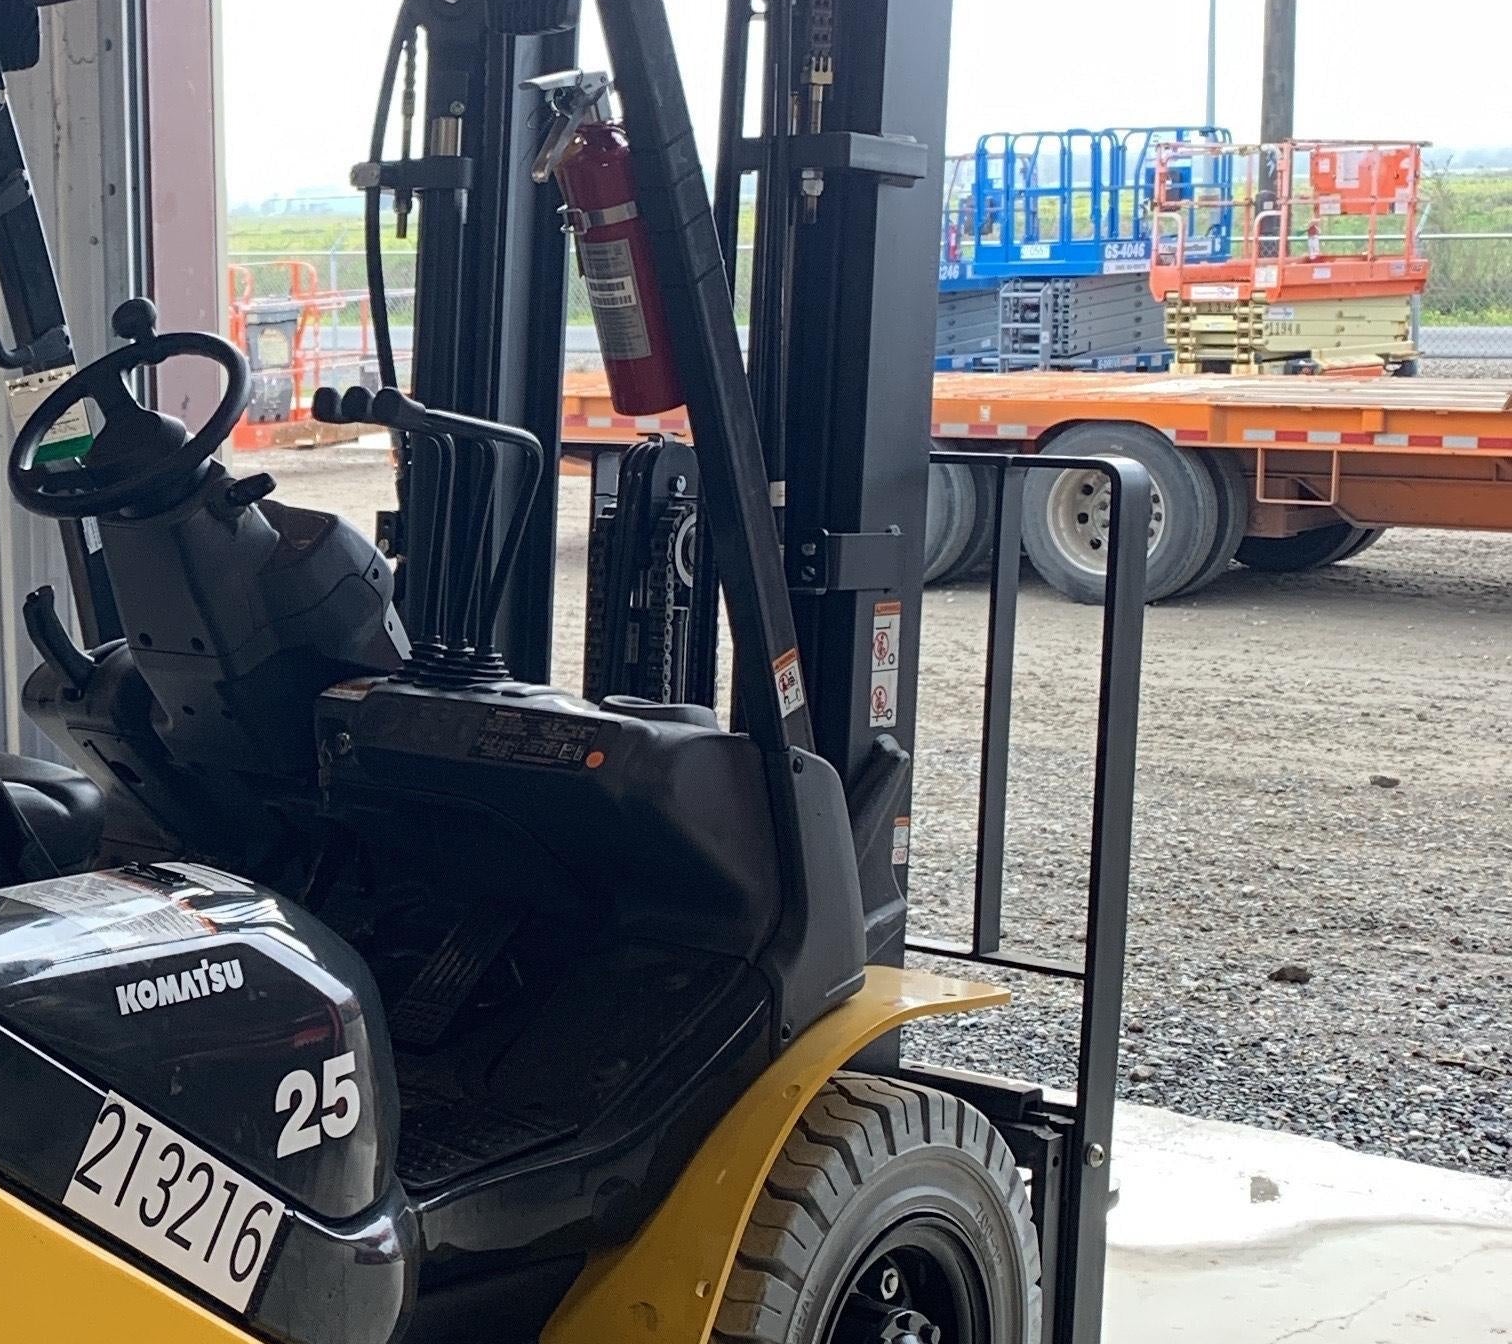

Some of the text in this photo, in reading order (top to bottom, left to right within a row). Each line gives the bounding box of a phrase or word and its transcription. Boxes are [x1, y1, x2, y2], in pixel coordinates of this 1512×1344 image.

[115, 958, 245, 1016] KOMATSU
[274, 1050, 361, 1159] 25
[73, 1102, 274, 1284] 213216
